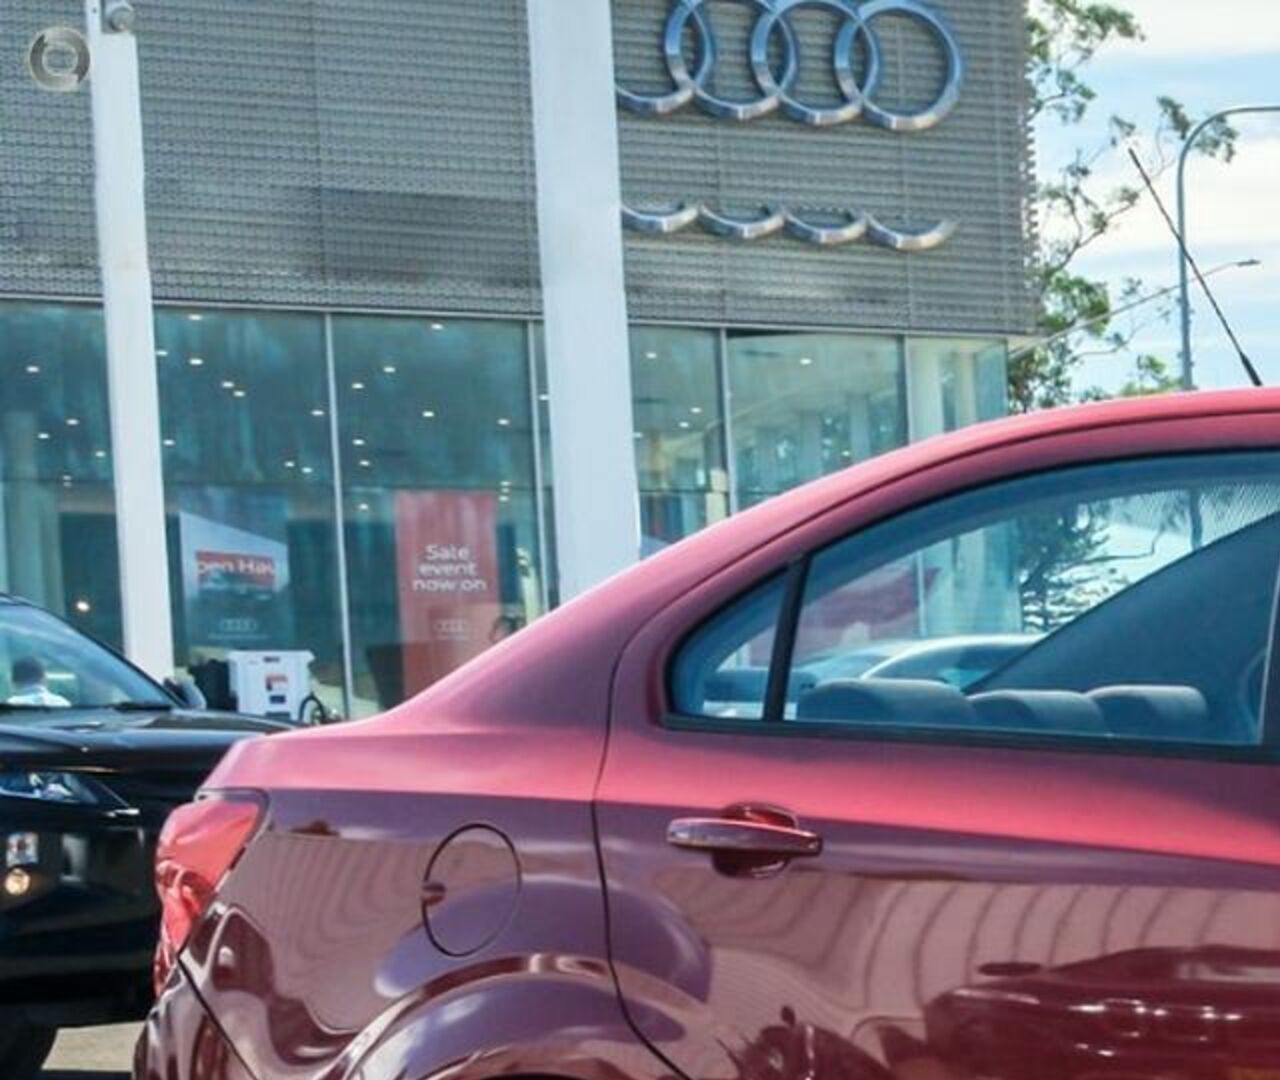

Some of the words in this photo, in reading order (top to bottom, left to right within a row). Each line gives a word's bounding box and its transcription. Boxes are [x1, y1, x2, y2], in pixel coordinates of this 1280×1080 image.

[425, 543, 470, 561] Sale
[196, 561, 236, 577] pen
[418, 560, 478, 577] event
[411, 578, 456, 593] now
[460, 578, 488, 593] on
